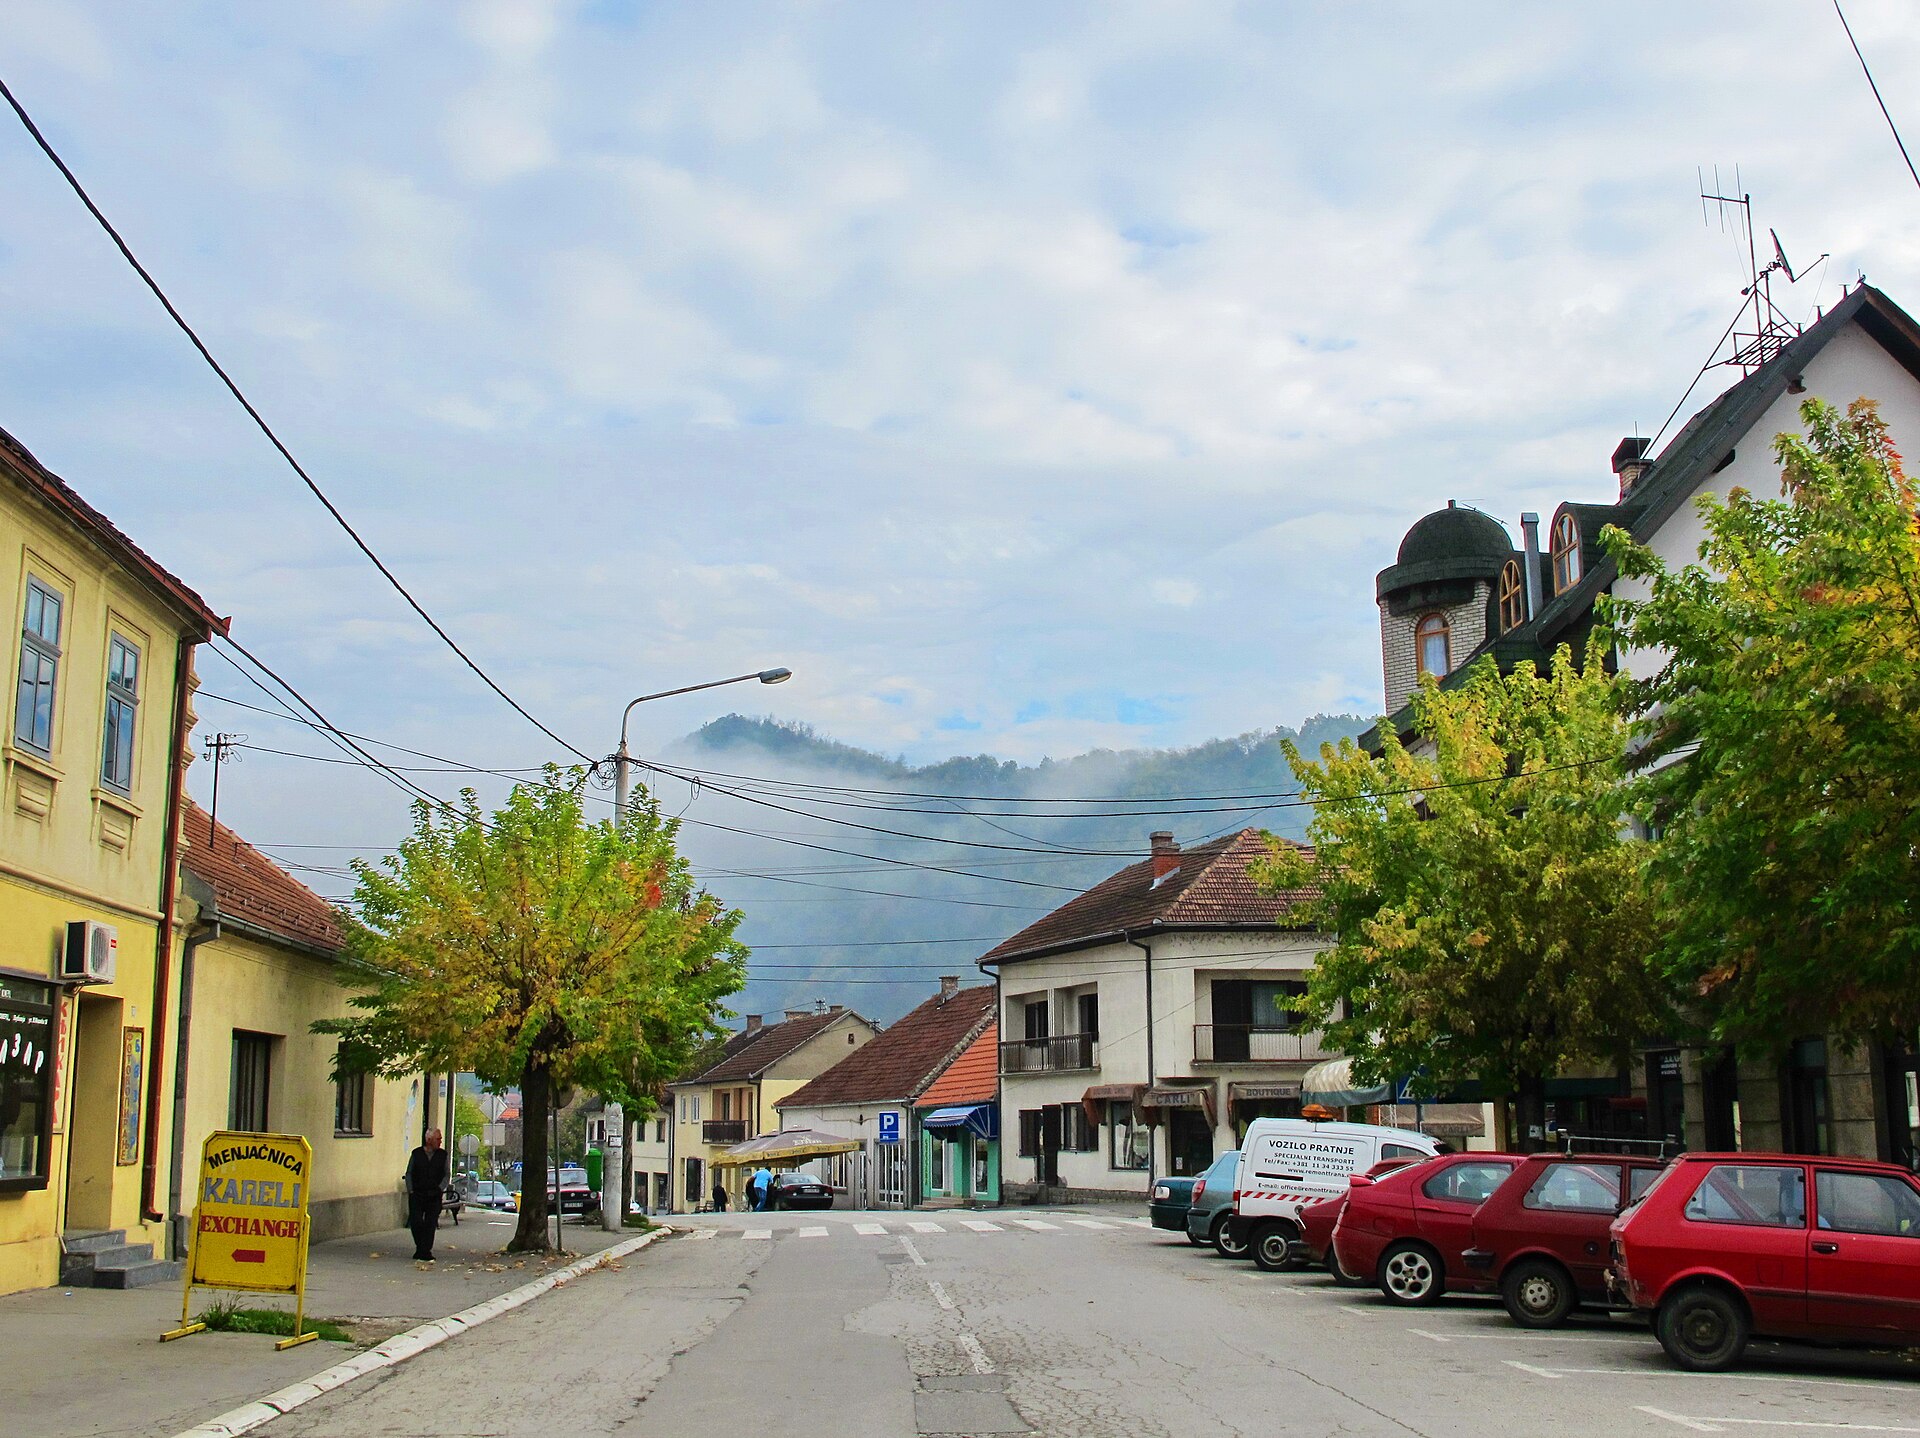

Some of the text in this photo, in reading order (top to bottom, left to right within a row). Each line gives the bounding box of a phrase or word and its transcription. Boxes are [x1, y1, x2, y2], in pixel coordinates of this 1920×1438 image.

[1246, 1087, 1291, 1097] BOUTIQUE
[883, 1114, 895, 1130] P
[1269, 1140, 1354, 1155] VOZILO PRATNJE
[208, 1144, 303, 1176] MENJAČNICA
[1274, 1152, 1354, 1165] SPECIJALNI TRANSPORTI
[203, 1177, 301, 1208] KARELI
[201, 1215, 301, 1238] EXCHANGE
